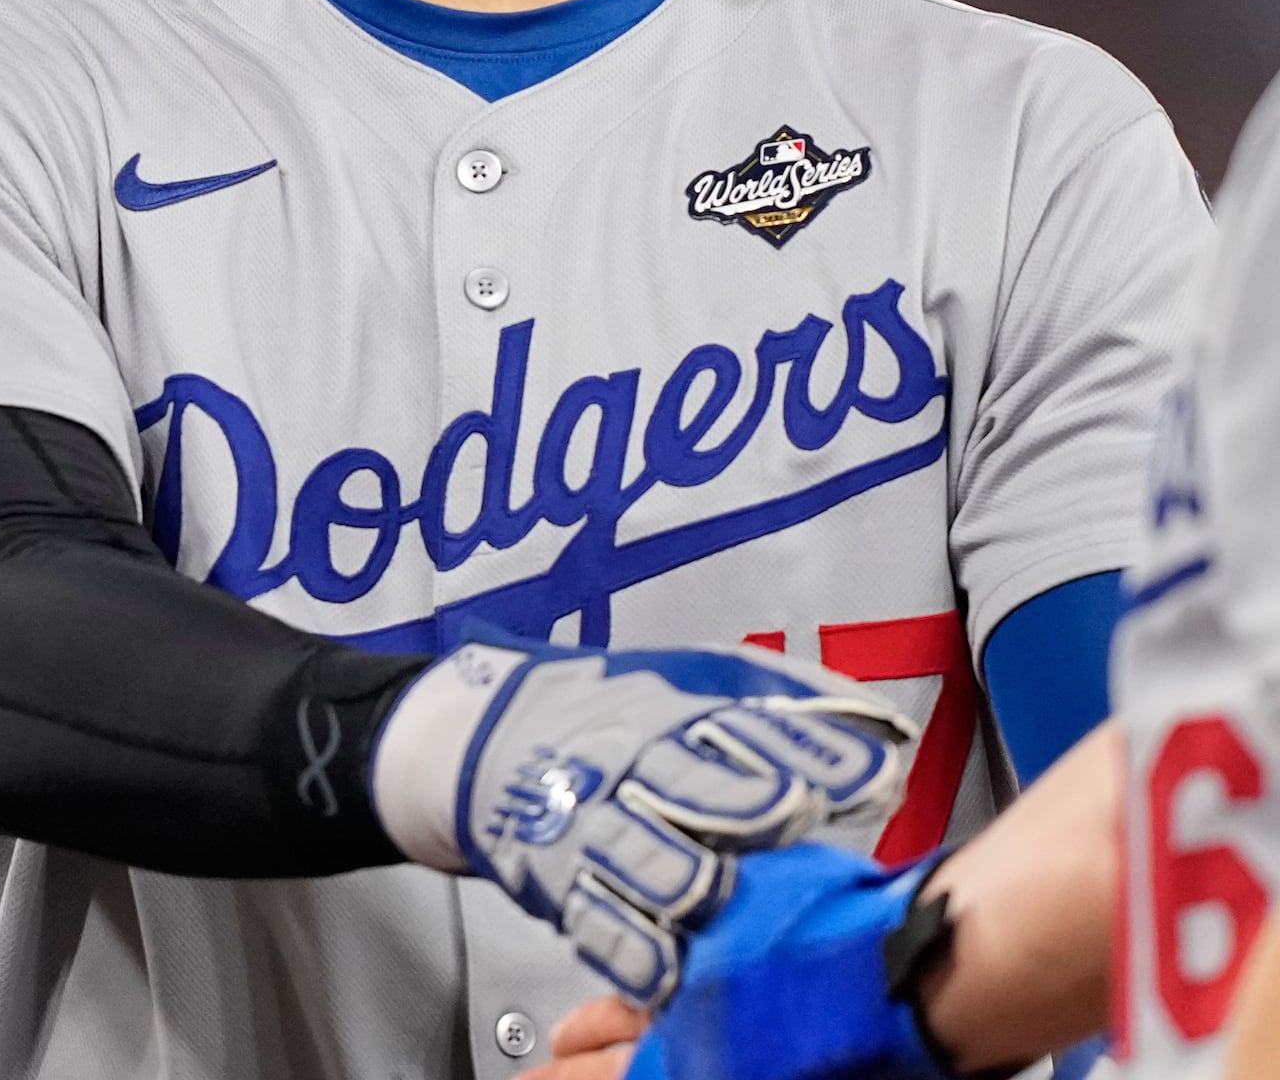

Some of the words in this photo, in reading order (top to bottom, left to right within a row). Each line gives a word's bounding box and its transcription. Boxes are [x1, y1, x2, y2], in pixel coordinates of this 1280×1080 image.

[694, 164, 794, 215] World
[774, 153, 864, 210] Series
[134, 277, 948, 652] Dodgers
[742, 610, 982, 868] 7
